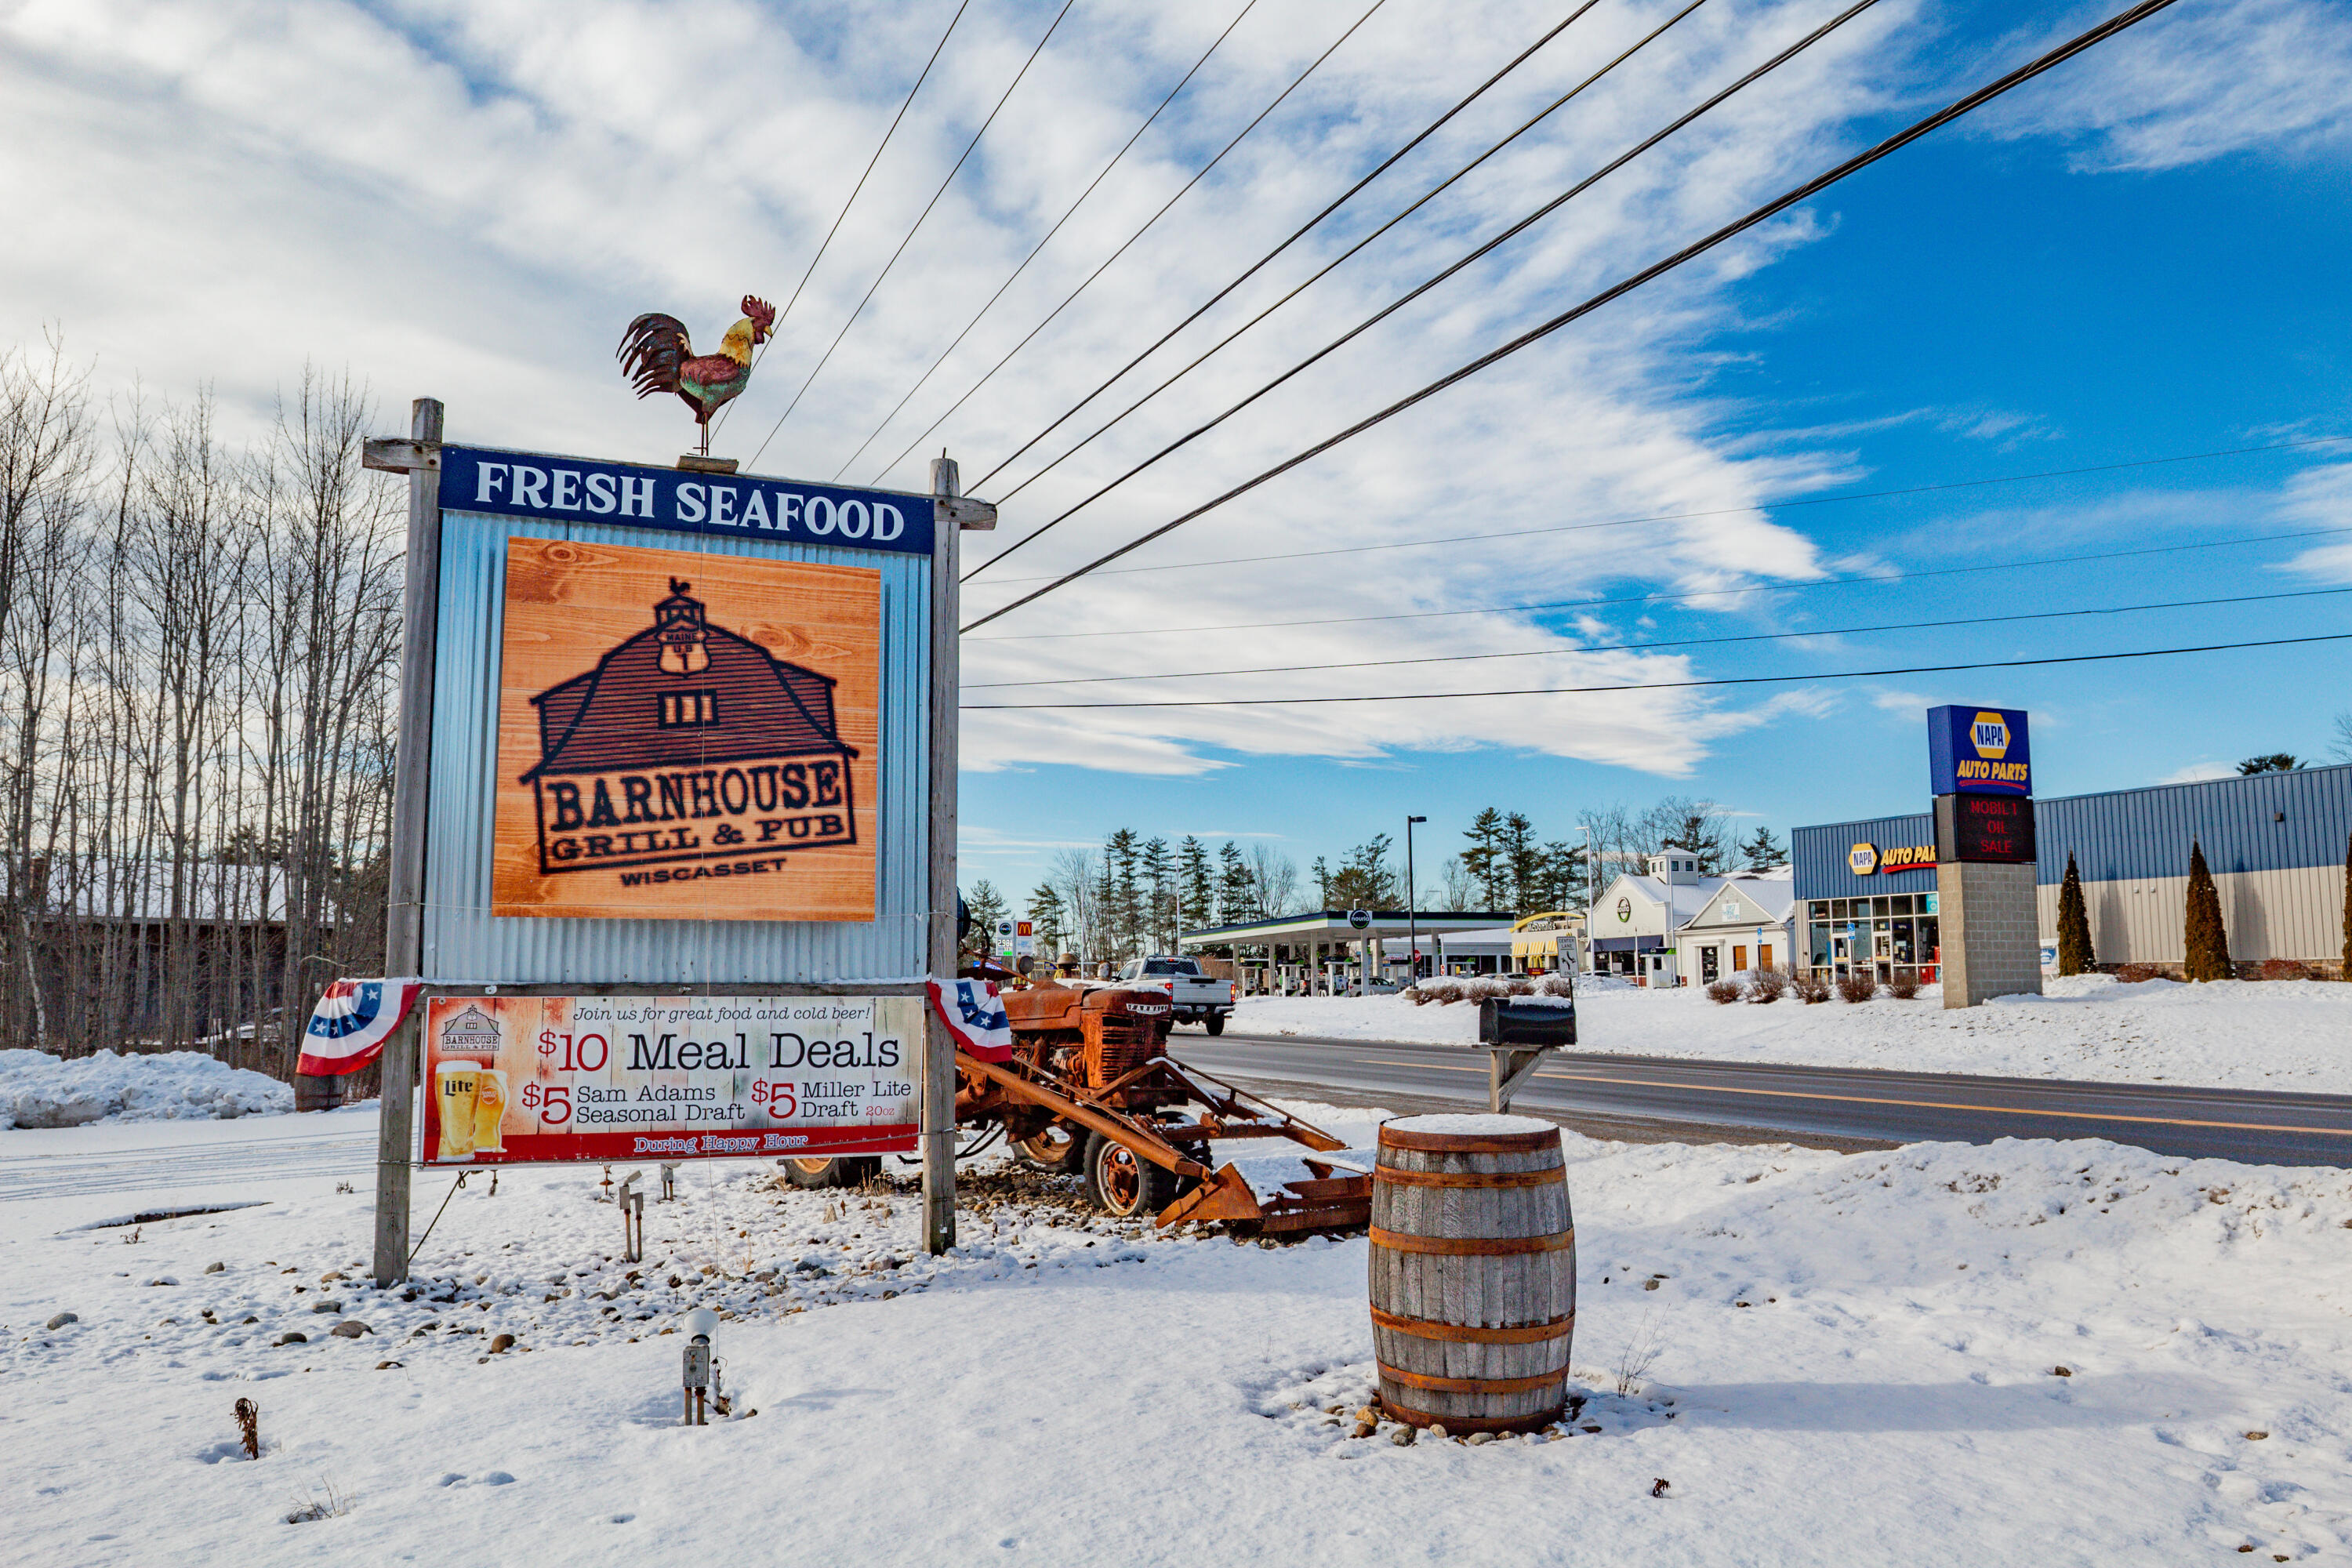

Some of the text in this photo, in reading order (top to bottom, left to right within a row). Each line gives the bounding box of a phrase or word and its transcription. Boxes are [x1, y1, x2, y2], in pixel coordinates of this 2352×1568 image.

[475, 461, 904, 541] FRESH SEAFOOD
[667, 633, 697, 641] MAINE
[1976, 724, 2005, 747] NAPA
[1957, 760, 2028, 781] AUTO PARTS
[548, 760, 843, 832] BARNHOUSE
[1970, 800, 2017, 815] MOBIL 1
[550, 814, 845, 861] GRILL & PUB
[1987, 821, 2008, 834] OIL
[1853, 844, 1936, 866] NAPA AUTO PAR
[1981, 840, 2013, 854] SALE
[620, 858, 788, 887] WISCASSET
[1527, 921, 1556, 931] McDonald's
[573, 1006, 870, 1023] Join us for great food and cold beer!
[445, 1035, 498, 1045] BARNHOUSE
[537, 1028, 901, 1073] $10 Meal Deals
[444, 1080, 473, 1097] Lite
[751, 1077, 911, 1119] $5 Miller Lite
[521, 1080, 716, 1124] $5 Sam Adams
[576, 1102, 746, 1123] Seasonal Draft
[800, 1100, 895, 1118] Draft 20oz
[634, 1133, 808, 1153] During Happy Hour
